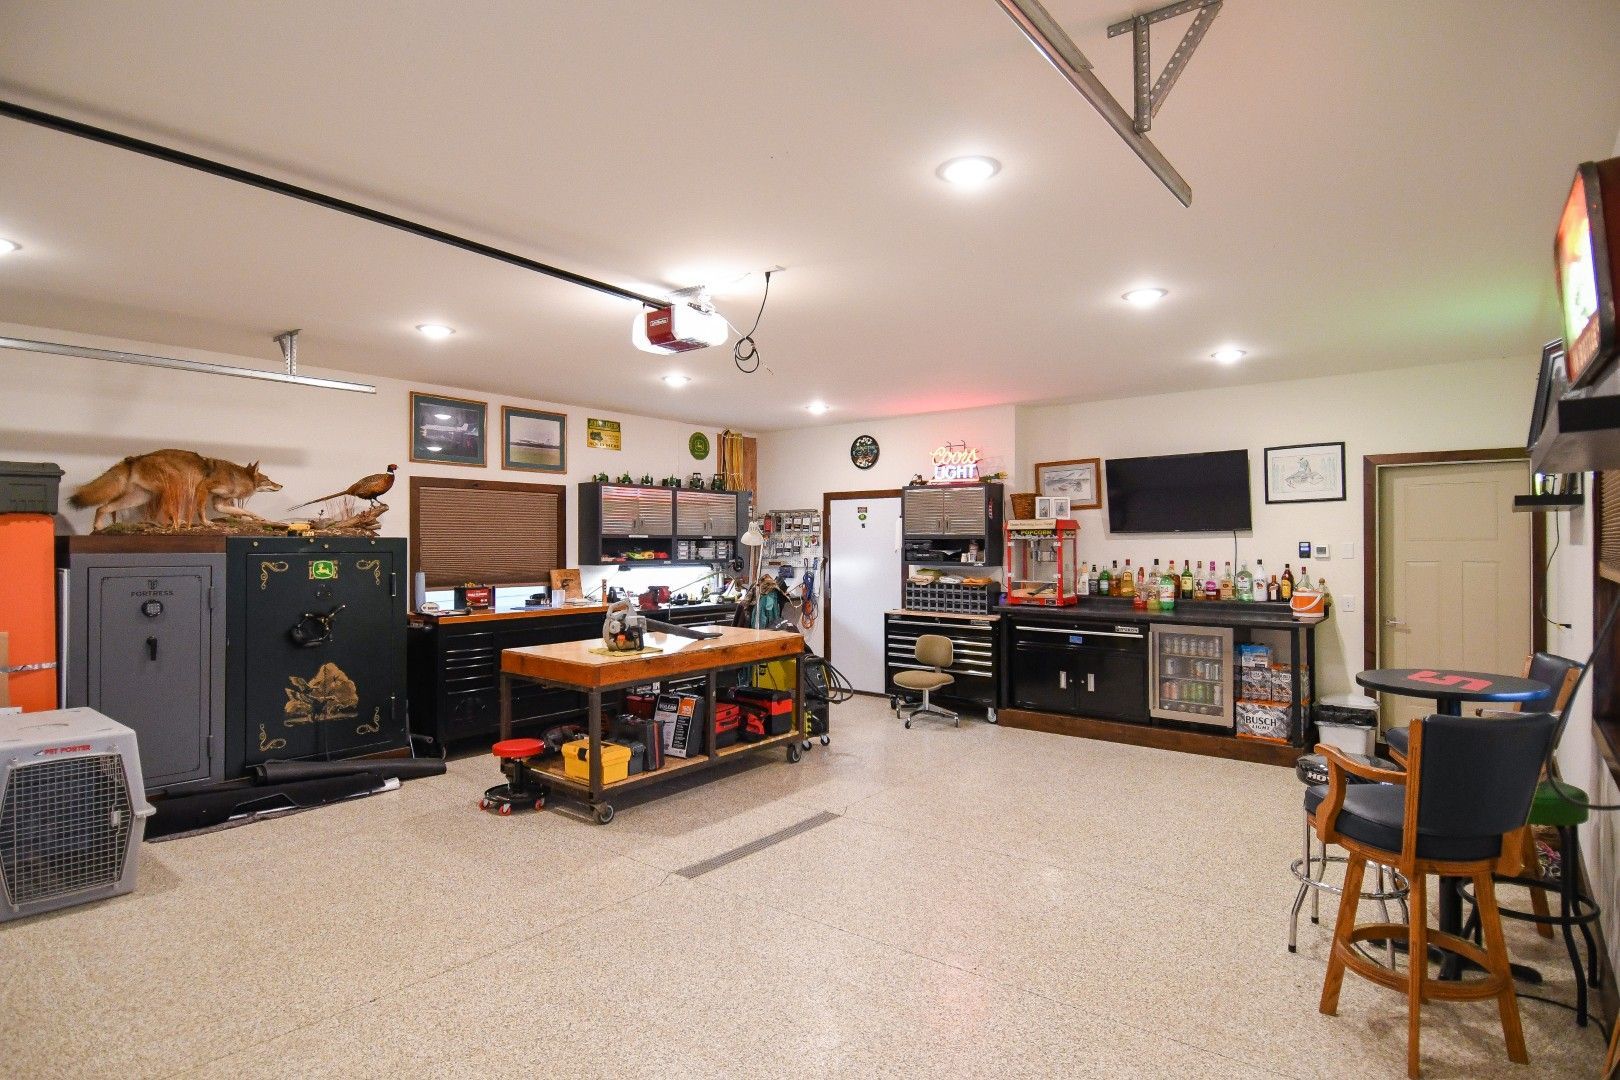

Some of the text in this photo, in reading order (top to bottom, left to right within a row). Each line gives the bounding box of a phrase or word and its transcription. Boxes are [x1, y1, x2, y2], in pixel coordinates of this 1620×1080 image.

[929, 446, 978, 465] Coors
[935, 464, 977, 480] LIGHT
[1245, 715, 1277, 727] BUSCH
